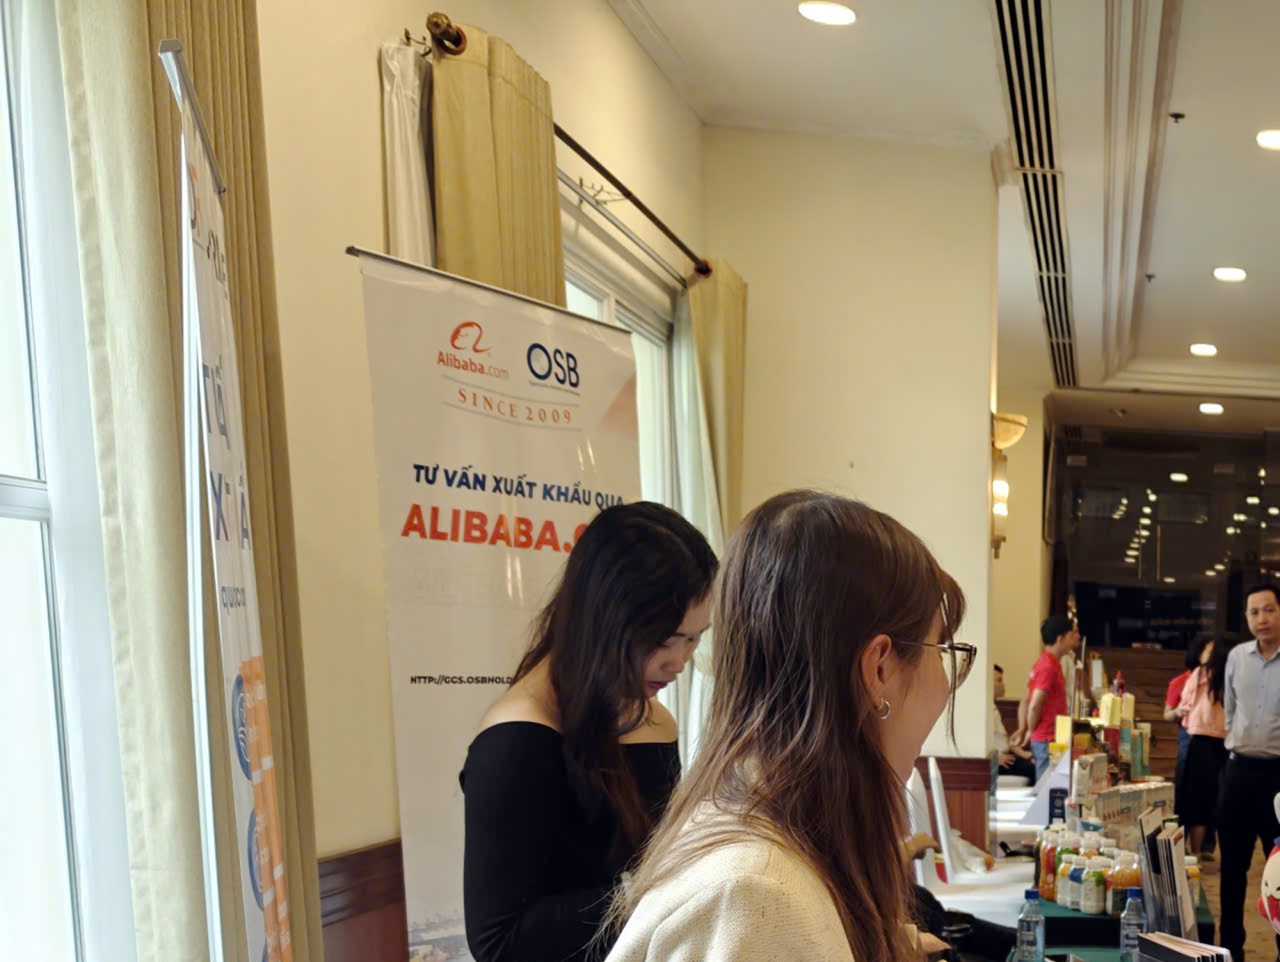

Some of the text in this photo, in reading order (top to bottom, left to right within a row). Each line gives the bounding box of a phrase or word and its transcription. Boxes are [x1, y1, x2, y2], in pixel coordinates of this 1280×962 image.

[437, 351, 509, 380] Alibaba.com
[527, 343, 580, 388] OSB
[458, 388, 572, 423] SINCE 2009
[413, 464, 624, 510] TƯ VẤN XUẤT KHẨU QUA
[410, 674, 512, 685] HTTP://CCS.OSBHOLD
